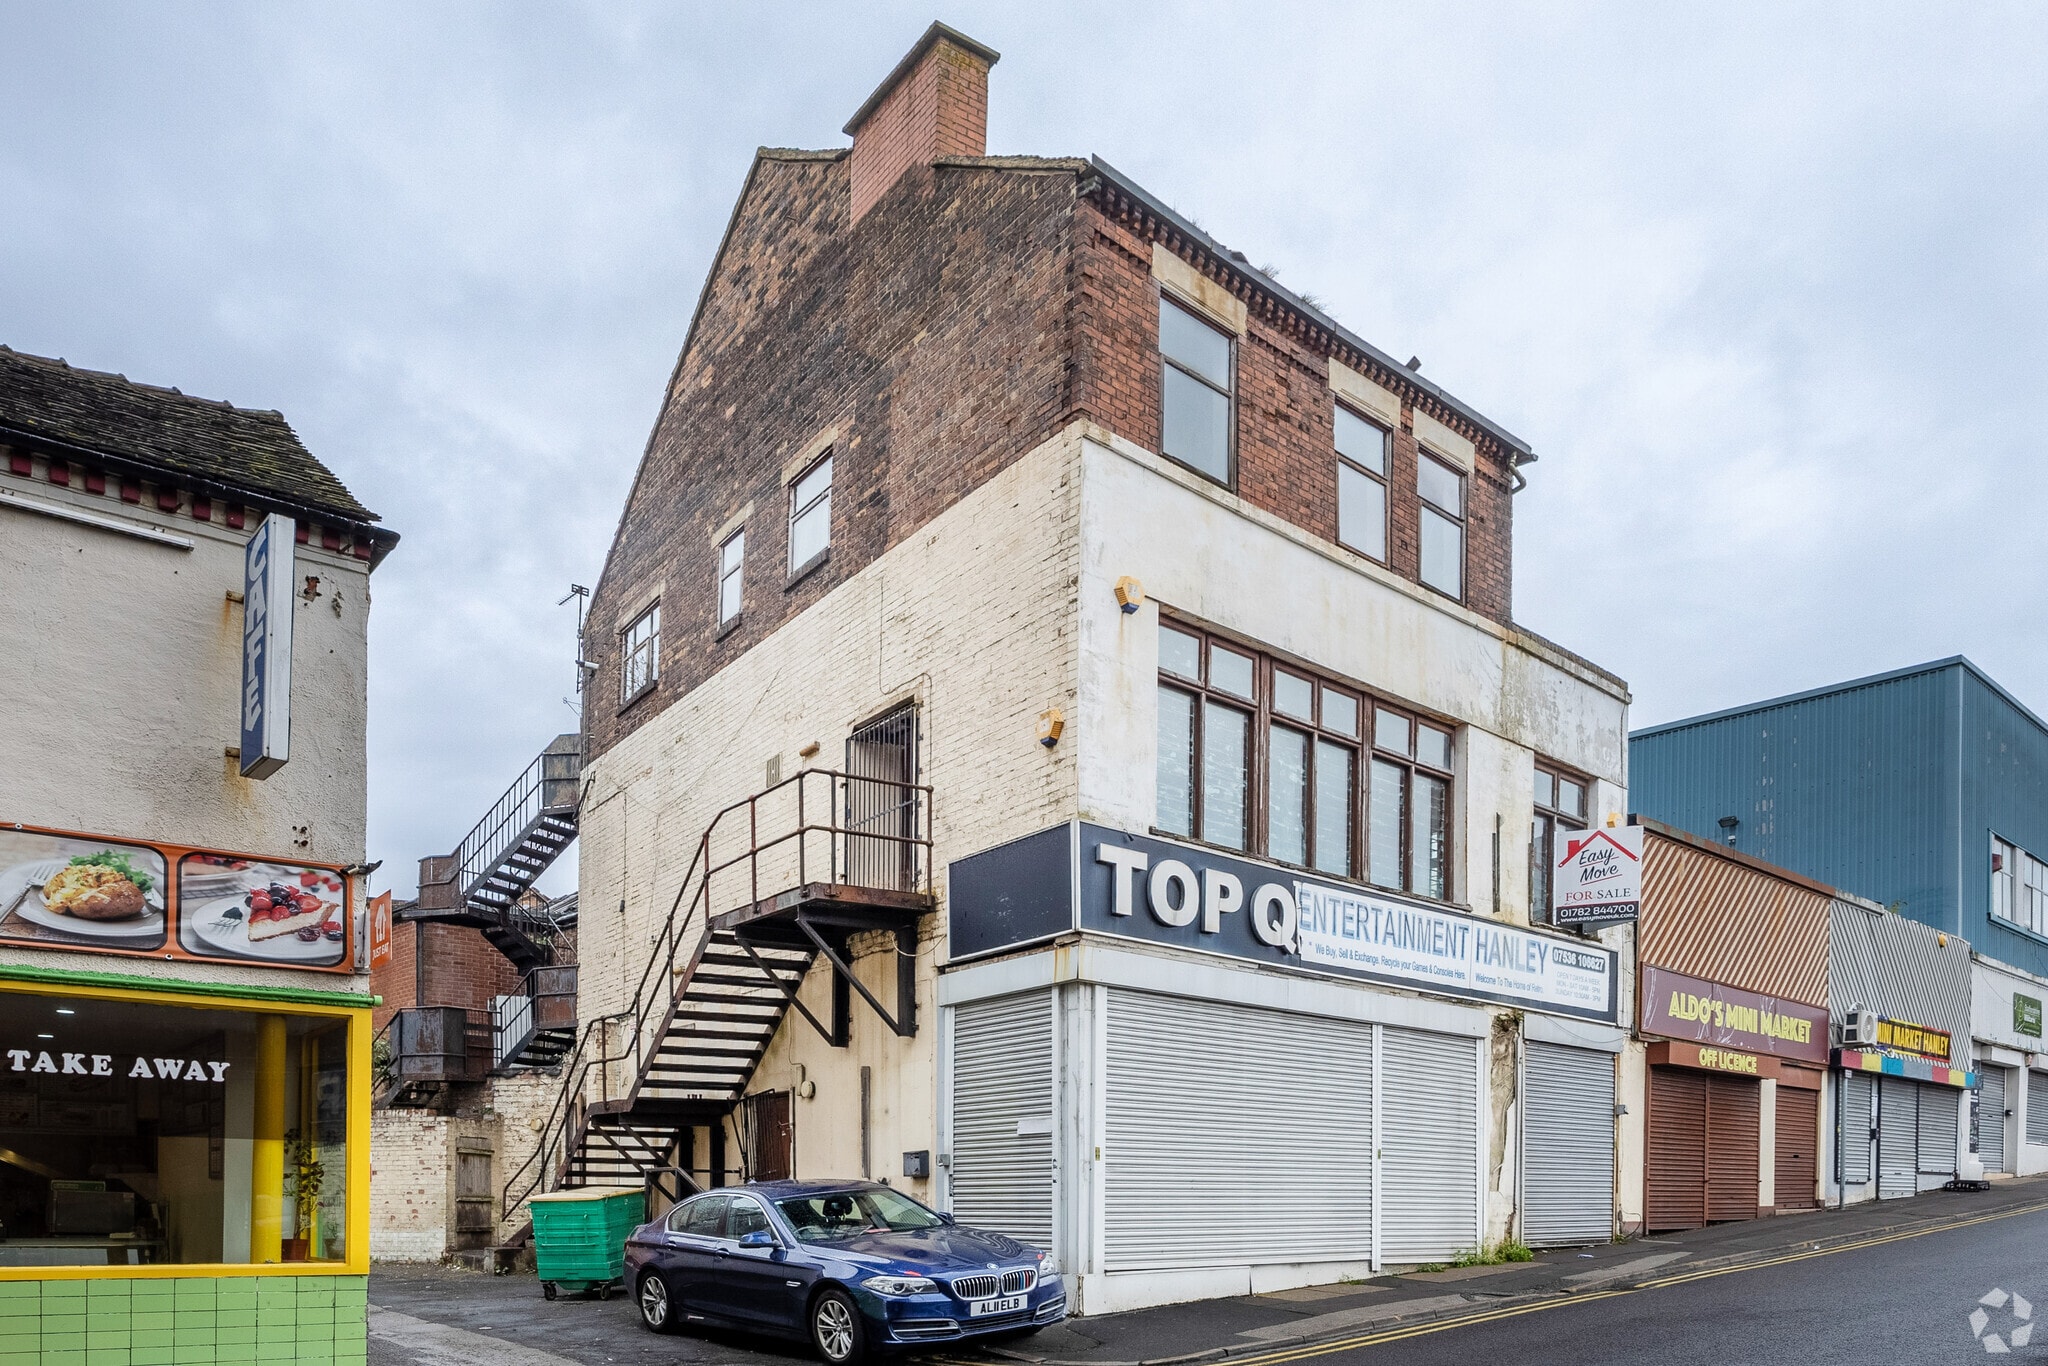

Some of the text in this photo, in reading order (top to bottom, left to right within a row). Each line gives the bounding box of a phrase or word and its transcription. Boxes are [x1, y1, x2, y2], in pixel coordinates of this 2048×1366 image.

[245, 526, 267, 732] CAFE
[1579, 848, 1614, 866] Easy
[1580, 865, 1619, 882] Move
[1095, 842, 1297, 955] TOP Q
[1565, 887, 1631, 902] FOR SALE
[1560, 904, 1635, 918] 01782 844700
[1560, 913, 1635, 923] www.easymoveuk.com
[1299, 888, 1549, 975] ENTERTAINMENT HANLEY
[373, 945, 381, 960] JUST
[1315, 943, 1325, 955] We
[1339, 948, 1349, 959] Sell
[1349, 949, 1354, 960] &
[1381, 955, 1400, 969] Recycle
[1401, 961, 1412, 971] your
[1412, 961, 1428, 974] Games
[1429, 964, 1433, 974] &
[1434, 965, 1454, 978] Consoles
[1475, 972, 1497, 985] Welcome
[1497, 976, 1504, 987] To
[1504, 977, 1513, 988] The
[1513, 979, 1526, 991] Home
[1668, 990, 1812, 1044] ALDO'S MINI MARKET
[1893, 1025, 1923, 1051] MARKET
[1923, 1032, 1949, 1057] HANLEY
[7, 1049, 231, 1082] TAKE AWAY
[1699, 1048, 1758, 1074] OFF LICENCE
